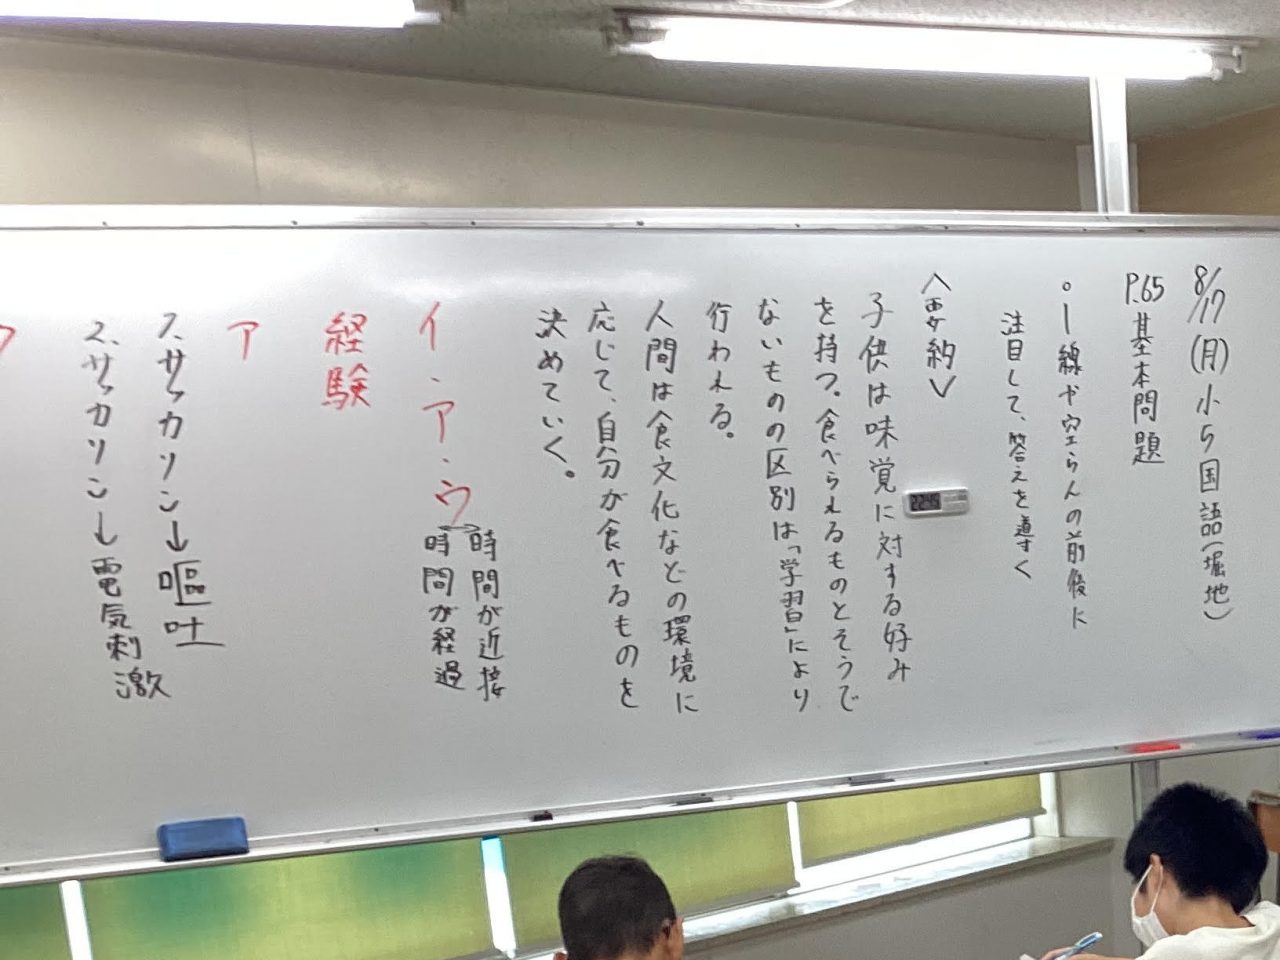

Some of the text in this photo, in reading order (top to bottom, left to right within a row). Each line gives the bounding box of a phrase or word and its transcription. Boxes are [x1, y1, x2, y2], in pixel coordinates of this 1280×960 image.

[227, 321, 260, 360] ア
[322, 312, 370, 410] 経験
[535, 307, 575, 478] 決めていく。
[706, 301, 734, 438] 行われる。
[645, 299, 699, 714] 人間は食文化などの環境に
[858, 292, 912, 682] 子供は味覚に対する好み
